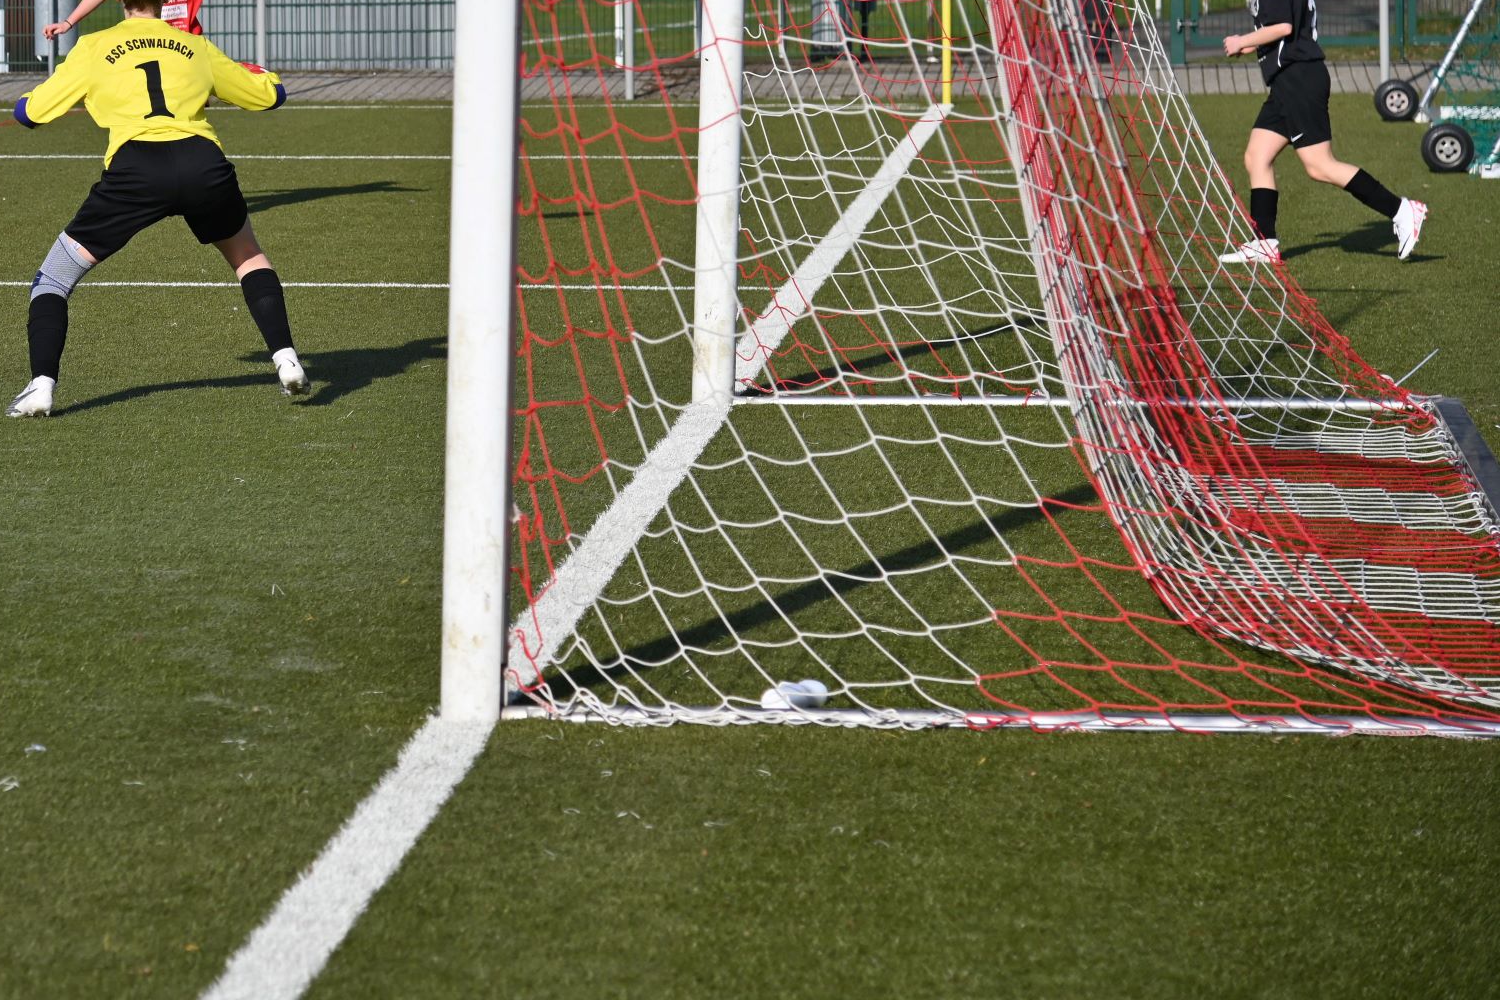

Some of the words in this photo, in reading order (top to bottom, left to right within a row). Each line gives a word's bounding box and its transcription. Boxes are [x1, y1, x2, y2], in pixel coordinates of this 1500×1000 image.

[105, 44, 127, 64] BSC
[126, 38, 195, 60] SCHWALBACH
[134, 59, 176, 120] 1
